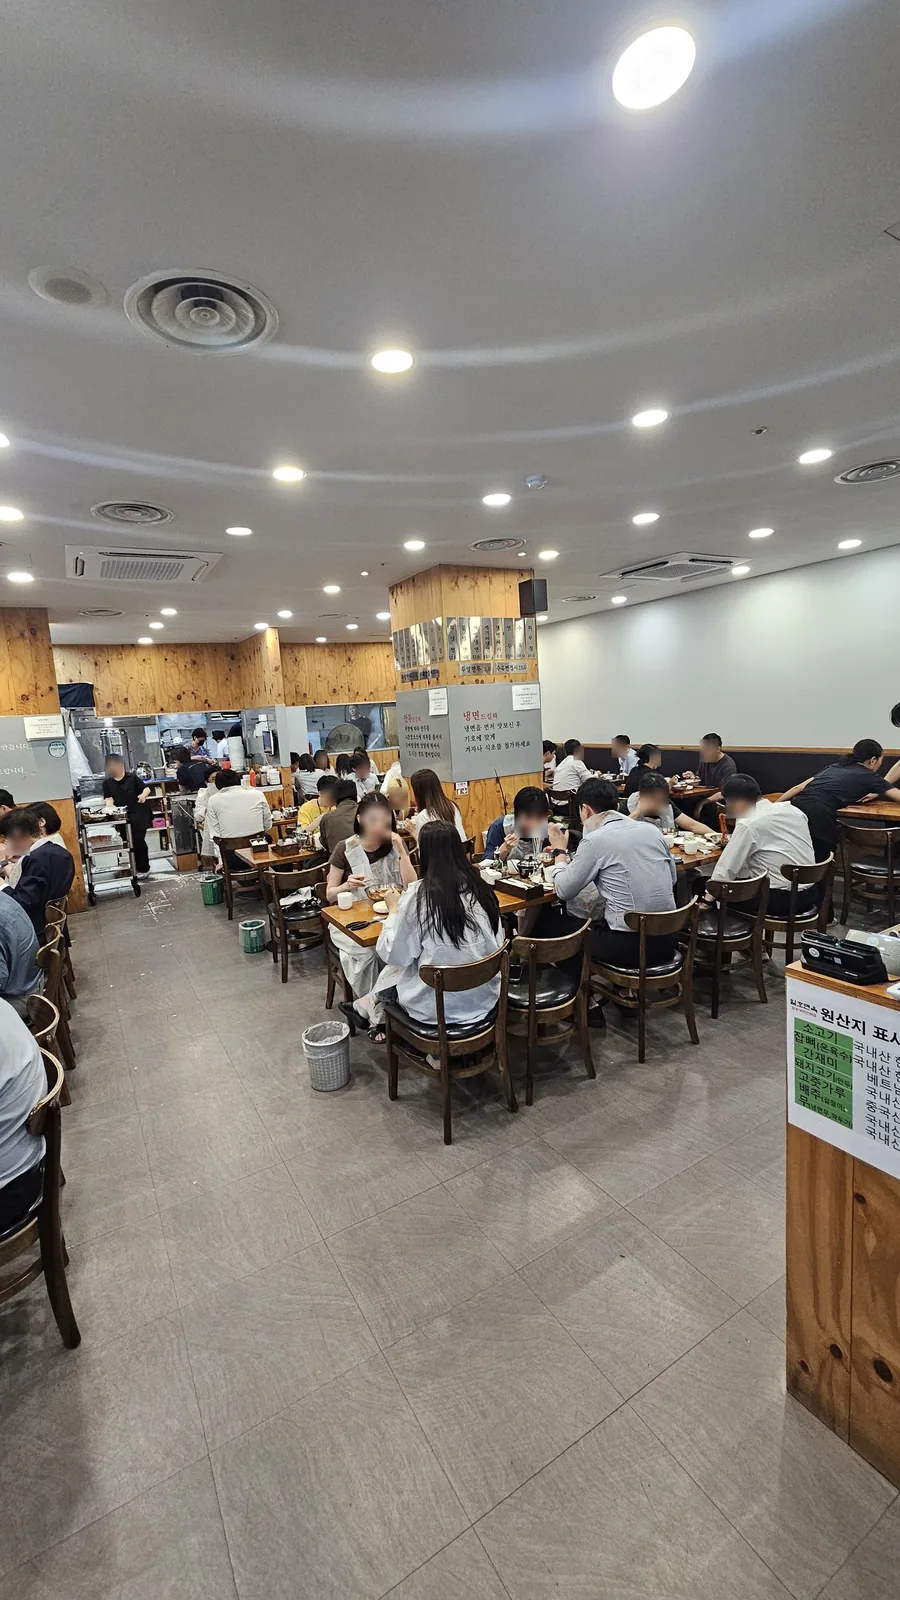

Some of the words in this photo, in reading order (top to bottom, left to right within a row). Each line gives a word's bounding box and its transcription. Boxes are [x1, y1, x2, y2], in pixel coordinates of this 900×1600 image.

[464, 724, 481, 732] 냉면을
[484, 722, 495, 731] 먼저
[497, 721, 514, 730] 맛보신
[515, 720, 521, 728] 후
[464, 734, 482, 742] 기호에
[484, 733, 495, 741] 맞게
[465, 745, 482, 753] 겨자나
[485, 743, 502, 751] 식초를
[504, 740, 531, 750] 첨가하세요
[820, 1007, 866, 1036] 원산지
[803, 1023, 838, 1045] 소고기
[803, 1047, 838, 1070] 간재미
[853, 1040, 891, 1064] 국내산
[853, 1054, 891, 1078] 국내산
[799, 1071, 847, 1098] 고춧가루
